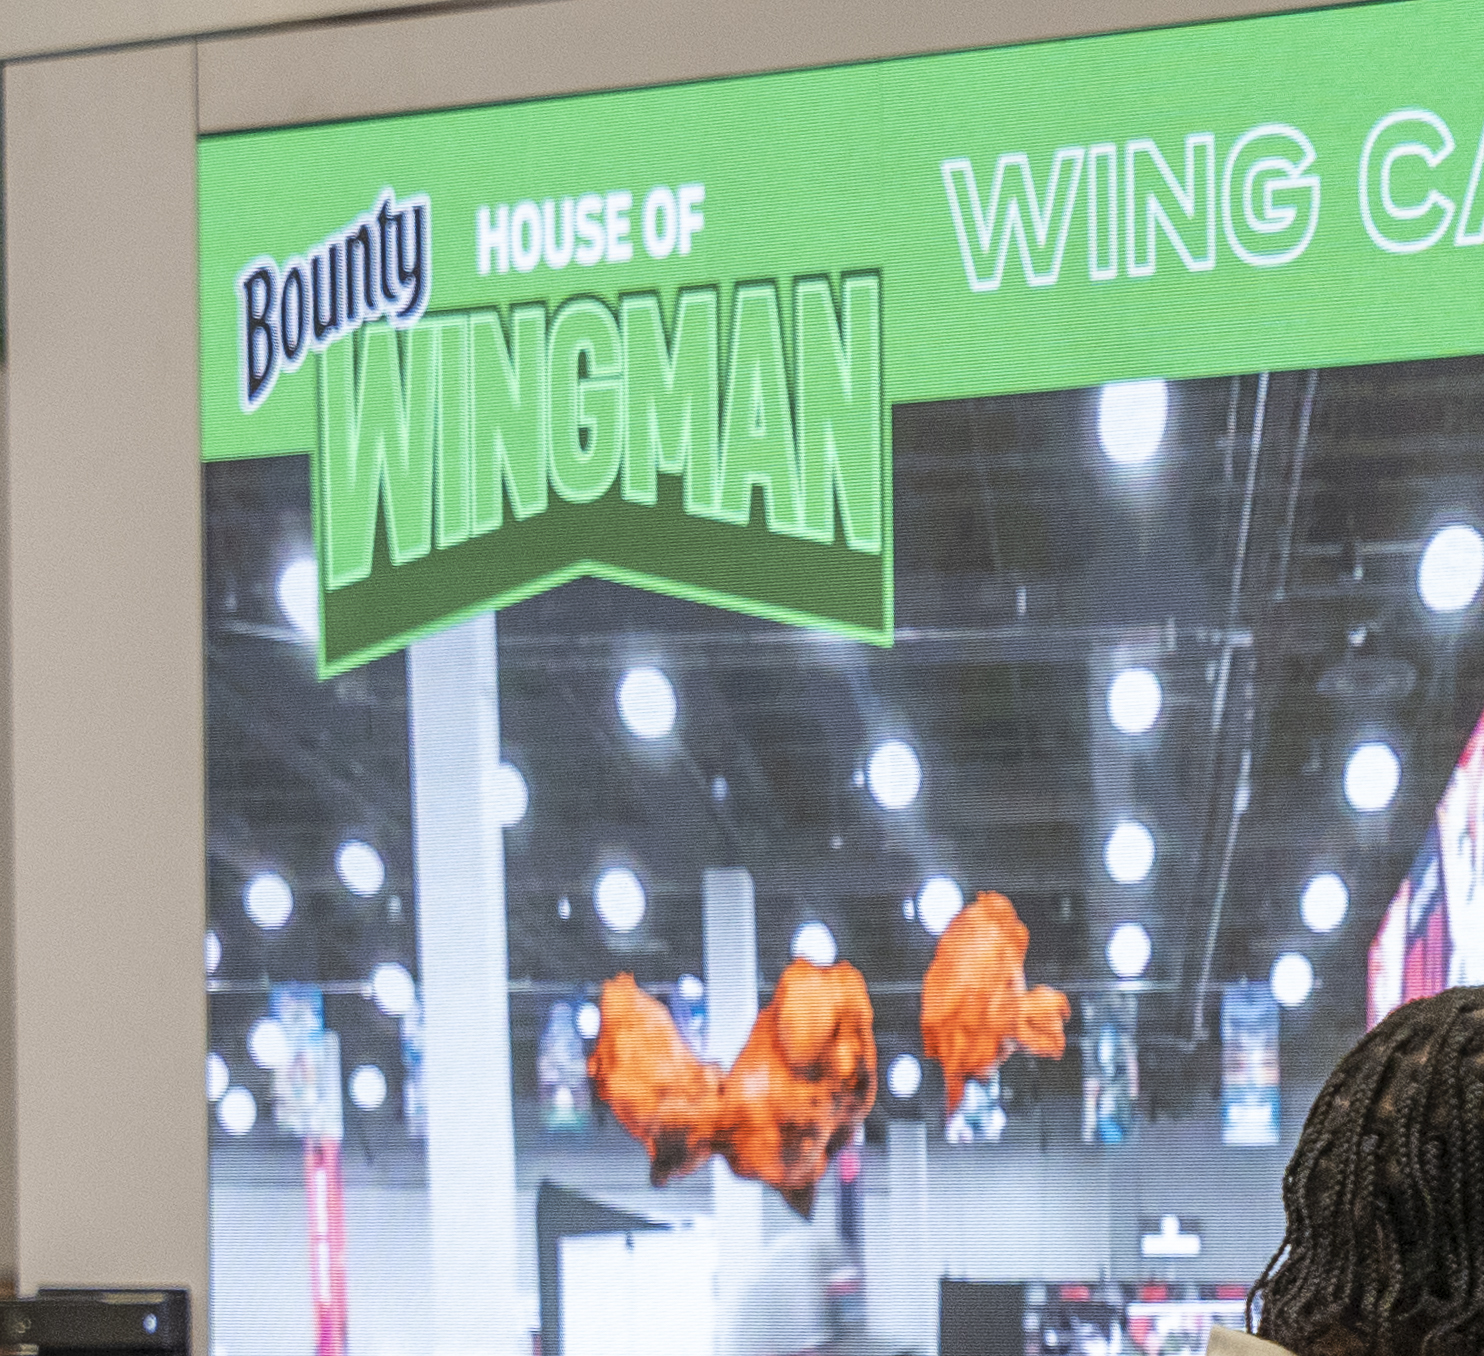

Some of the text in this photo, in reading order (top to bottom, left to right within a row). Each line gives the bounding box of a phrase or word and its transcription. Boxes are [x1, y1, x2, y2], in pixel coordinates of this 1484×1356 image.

[236, 185, 432, 413] Bounty
[474, 183, 707, 276] HOUSE OF
[939, 121, 1323, 293] WING
[316, 268, 884, 594] WINGMAN
